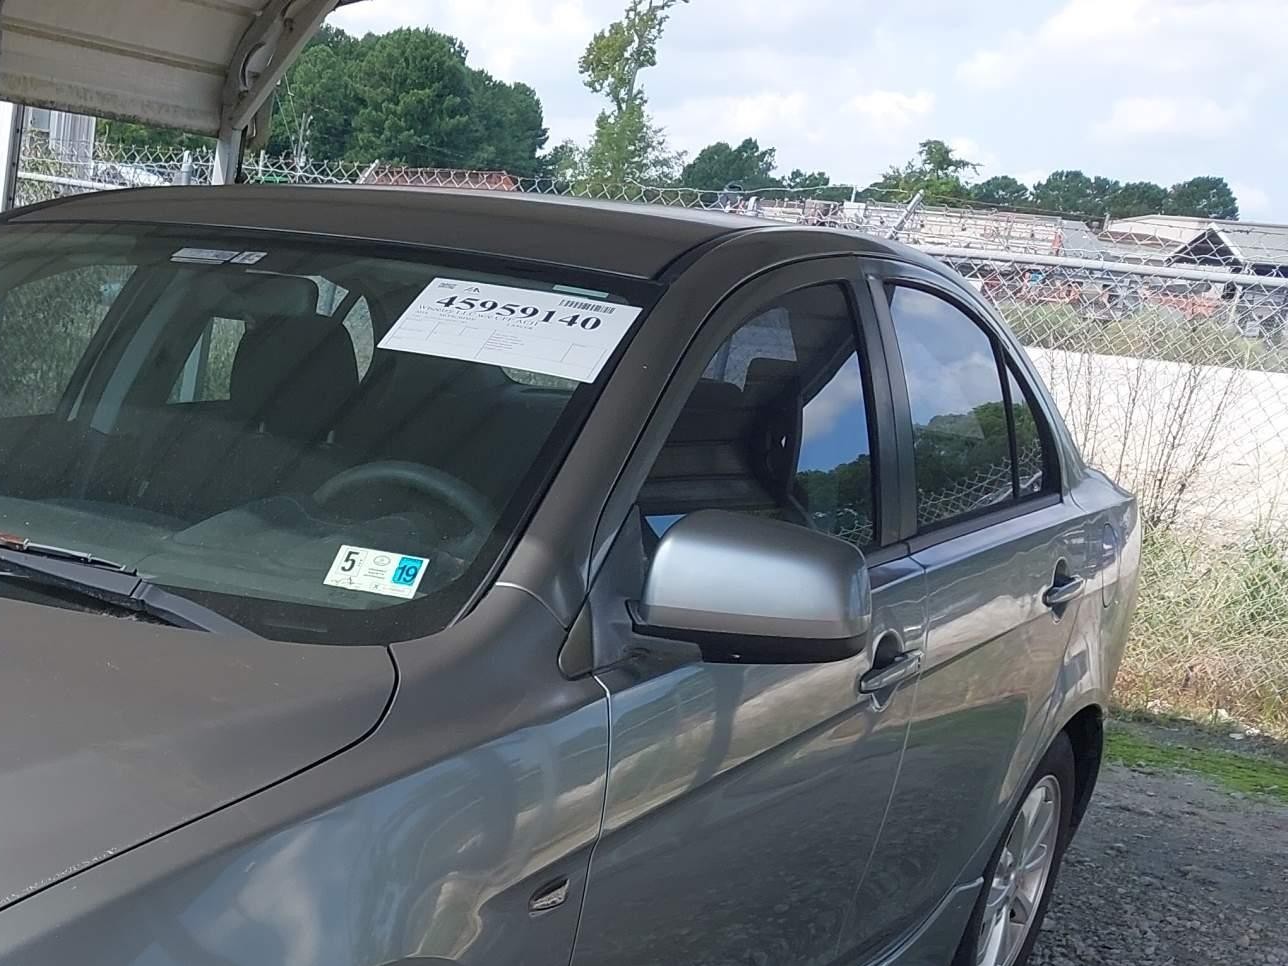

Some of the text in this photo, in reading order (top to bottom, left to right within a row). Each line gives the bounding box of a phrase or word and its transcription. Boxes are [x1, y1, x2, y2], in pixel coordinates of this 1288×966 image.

[435, 295, 602, 331] 45959140
[341, 551, 360, 572] 5
[396, 564, 418, 583] 19
